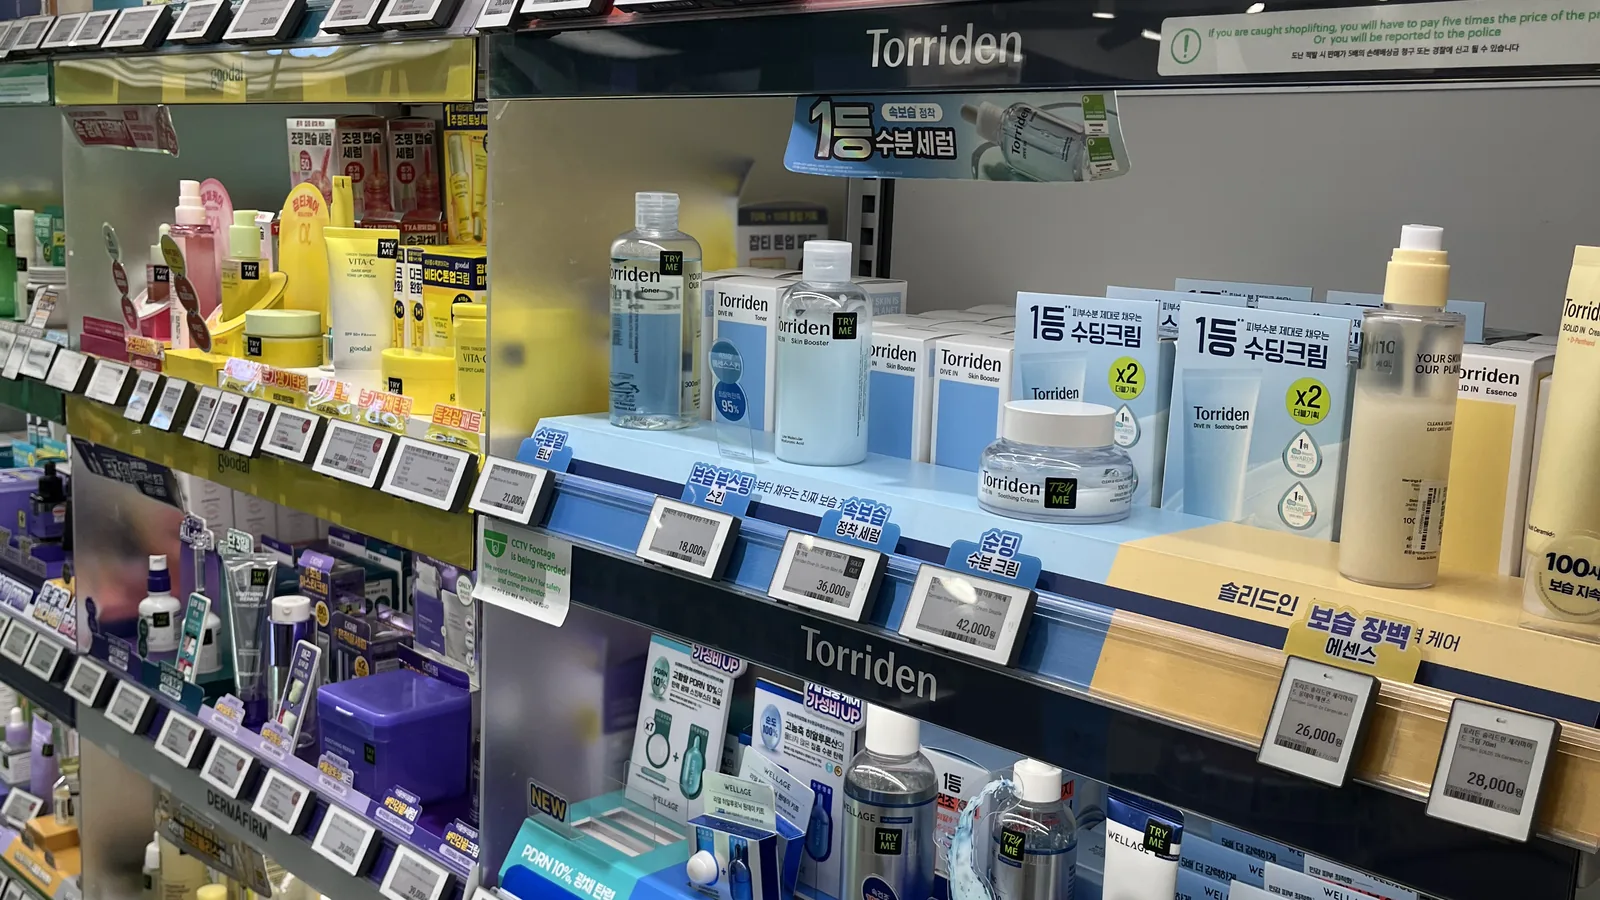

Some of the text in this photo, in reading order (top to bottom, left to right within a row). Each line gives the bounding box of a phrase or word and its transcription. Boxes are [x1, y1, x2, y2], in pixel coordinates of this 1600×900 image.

[1208, 28, 1217, 38] If
[1217, 29, 1233, 39] you
[1235, 28, 1249, 37] are
[1251, 26, 1283, 38] caught
[1285, 23, 1338, 36] shoplifting,
[1340, 23, 1357, 33] you
[1360, 21, 1378, 31] will
[1380, 19, 1405, 30] have
[1406, 18, 1418, 28] to
[1420, 19, 1440, 30] pay
[1442, 15, 1462, 27] five
[1464, 14, 1495, 26] times
[1498, 13, 1517, 24] the
[1519, 12, 1548, 25] price
[1550, 9, 1564, 21] of
[1566, 9, 1585, 20] the
[866, 22, 1023, 68] Torriden
[1313, 26, 1502, 46] Or you will be reported to the police
[1455, 45, 1470, 55] 신고
[1480, 45, 1488, 54] 수
[1490, 43, 1520, 53] 있습니다
[210, 62, 244, 91] goodal
[888, 104, 937, 120] 속보습 정착
[341, 131, 382, 145] 조명 캡슐
[810, 97, 874, 161] 1등
[1010, 106, 1033, 156] Torriden
[342, 146, 363, 159] 세럼
[395, 147, 415, 160] 세럼
[875, 129, 957, 159] 수분 세럼
[380, 241, 396, 249] TRY
[749, 234, 795, 251] 잡티 톤업
[663, 254, 681, 263] TRY
[665, 263, 679, 271] ME
[424, 268, 471, 287] 비타C톤업크림
[610, 264, 660, 283] orriden
[718, 291, 768, 312] Torriden
[754, 314, 768, 322] Toner
[836, 317, 855, 326] TRY
[1030, 305, 1066, 342] 1등
[1072, 307, 1143, 322] 피부수분 제대로 채우는
[778, 315, 831, 337] orriden
[838, 326, 853, 335] ME
[1070, 321, 1142, 348] 수딩크림
[1246, 321, 1330, 341] 피부수분 제대로 채우는
[790, 337, 830, 347] Skin Booster
[1195, 316, 1238, 358] 1등
[349, 345, 372, 353] goodal
[1243, 336, 1328, 370] 수딩크림
[886, 362, 896, 371] Skin
[896, 363, 916, 373] Booster
[941, 348, 1002, 373] Torriden
[1415, 364, 1439, 375] OUR
[389, 381, 401, 389] TRY
[939, 367, 1001, 383] DIVE IN Skin Booster
[1031, 387, 1079, 400] Torriden
[1470, 385, 1518, 398] IN Essence
[721, 400, 740, 415] 95%
[1193, 405, 1250, 422] Torriden
[534, 428, 569, 450] 수분결
[217, 453, 250, 475] goodal
[535, 447, 552, 462] 토너
[982, 470, 1041, 496] Torriden
[1048, 482, 1075, 494] TRY
[705, 490, 725, 505] 스킨
[773, 481, 838, 510] 채우는 진짜 보습
[1052, 495, 1070, 505] ME
[842, 500, 890, 528] 속보습
[836, 521, 882, 544] 정착 세럼
[510, 538, 556, 561] CCTV Footage
[981, 530, 1017, 558] 순딩
[510, 552, 567, 577] is being recorded
[967, 552, 1020, 578] 수분 크림
[496, 576, 508, 587] and
[508, 580, 520, 591] crime
[507, 567, 527, 582] footage
[546, 579, 562, 593] safety
[816, 579, 851, 600] 36,000원
[1217, 581, 1299, 618] 솔리드인
[955, 617, 996, 640] 42,000원
[1306, 604, 1412, 651] 보습 장벽
[1325, 637, 1378, 665] 에센스
[1425, 629, 1461, 652] 케어
[691, 643, 740, 674] 가성비 UP
[800, 624, 938, 700] Torriden
[806, 690, 842, 720] 가성비
[841, 703, 862, 725] UP
[1295, 722, 1343, 749] 26,000원
[763, 767, 792, 791] WELLAGE
[943, 772, 962, 794] 1등
[1466, 770, 1524, 799] 28,000원
[723, 783, 753, 797] WELLAGE
[530, 784, 568, 823] NEW
[206, 789, 270, 842] DERMAFIRM
[878, 832, 899, 842] TRY
[1003, 831, 1024, 846] TRY
[1150, 825, 1169, 838] TRY
[879, 841, 897, 850] ME
[1004, 844, 1018, 856] ME
[1149, 836, 1164, 850] ME
[1221, 837, 1277, 863] 5배 더 강력하게
[521, 844, 553, 872] PDRN
[573, 871, 595, 893] 광채
[594, 880, 616, 900] 탄력
[1180, 856, 1194, 868] 5배
[1195, 860, 1204, 872] 더
